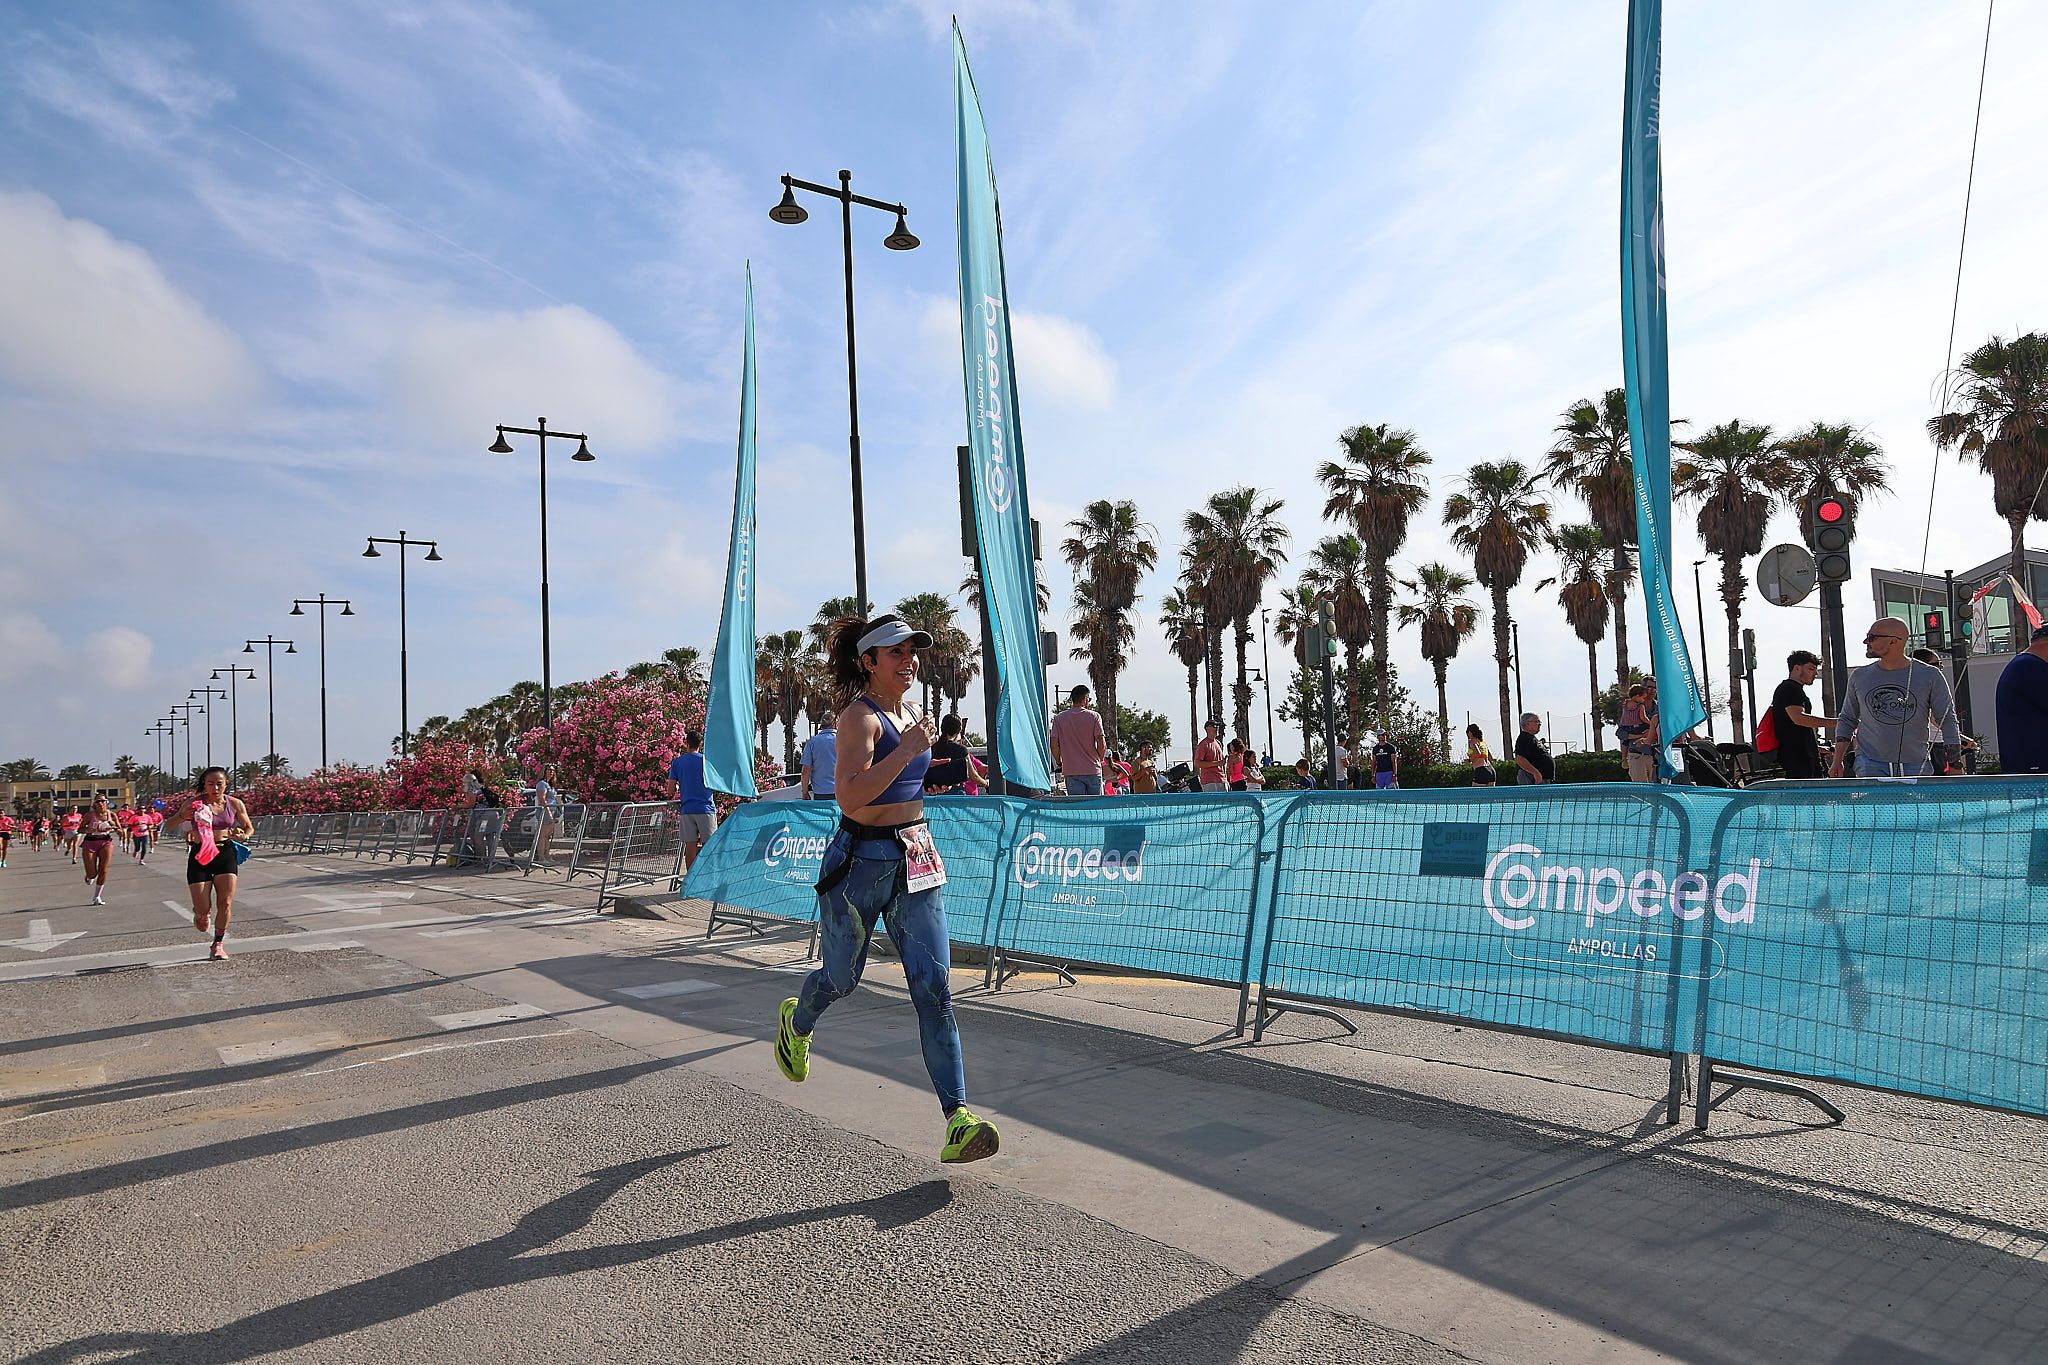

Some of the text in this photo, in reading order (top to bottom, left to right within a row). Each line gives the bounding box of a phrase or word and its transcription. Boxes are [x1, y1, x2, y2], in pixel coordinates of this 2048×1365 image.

[1636, 473, 1656, 525] sanitarios.
[1656, 592, 1678, 641] normativa
[1671, 643, 1682, 653] la
[1677, 654, 1689, 672] con
[1015, 832, 1147, 888] Compeed
[1052, 893, 1097, 907] AMPOLLAS
[1567, 937, 1657, 961] AMPOLLAS
